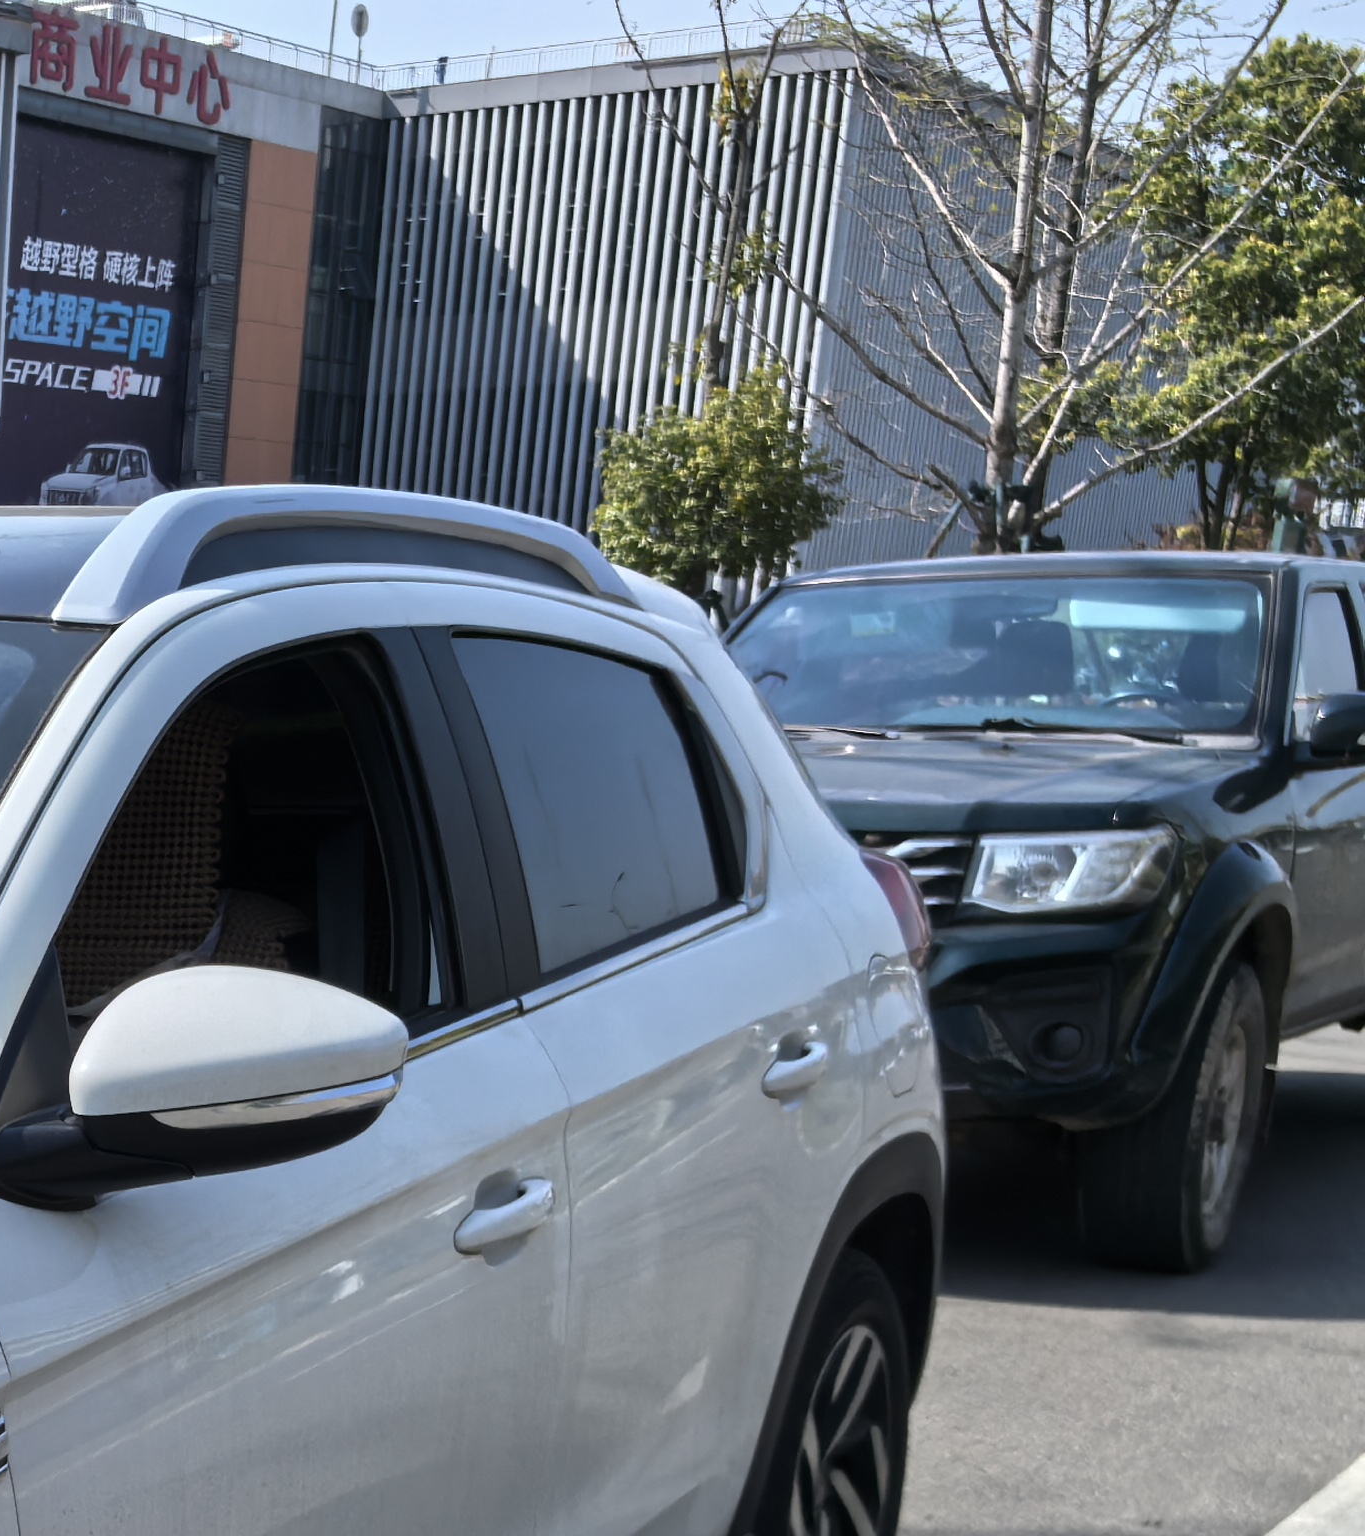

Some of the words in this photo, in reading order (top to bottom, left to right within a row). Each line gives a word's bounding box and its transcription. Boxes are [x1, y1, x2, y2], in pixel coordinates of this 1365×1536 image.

[30, 9, 230, 125] 商业中心
[20, 235, 98, 281] 越野型格
[103, 250, 177, 293] 硬核上阵
[6, 287, 172, 361] 越野空间
[2, 358, 92, 392] SPACE
[107, 365, 134, 399] 3F
